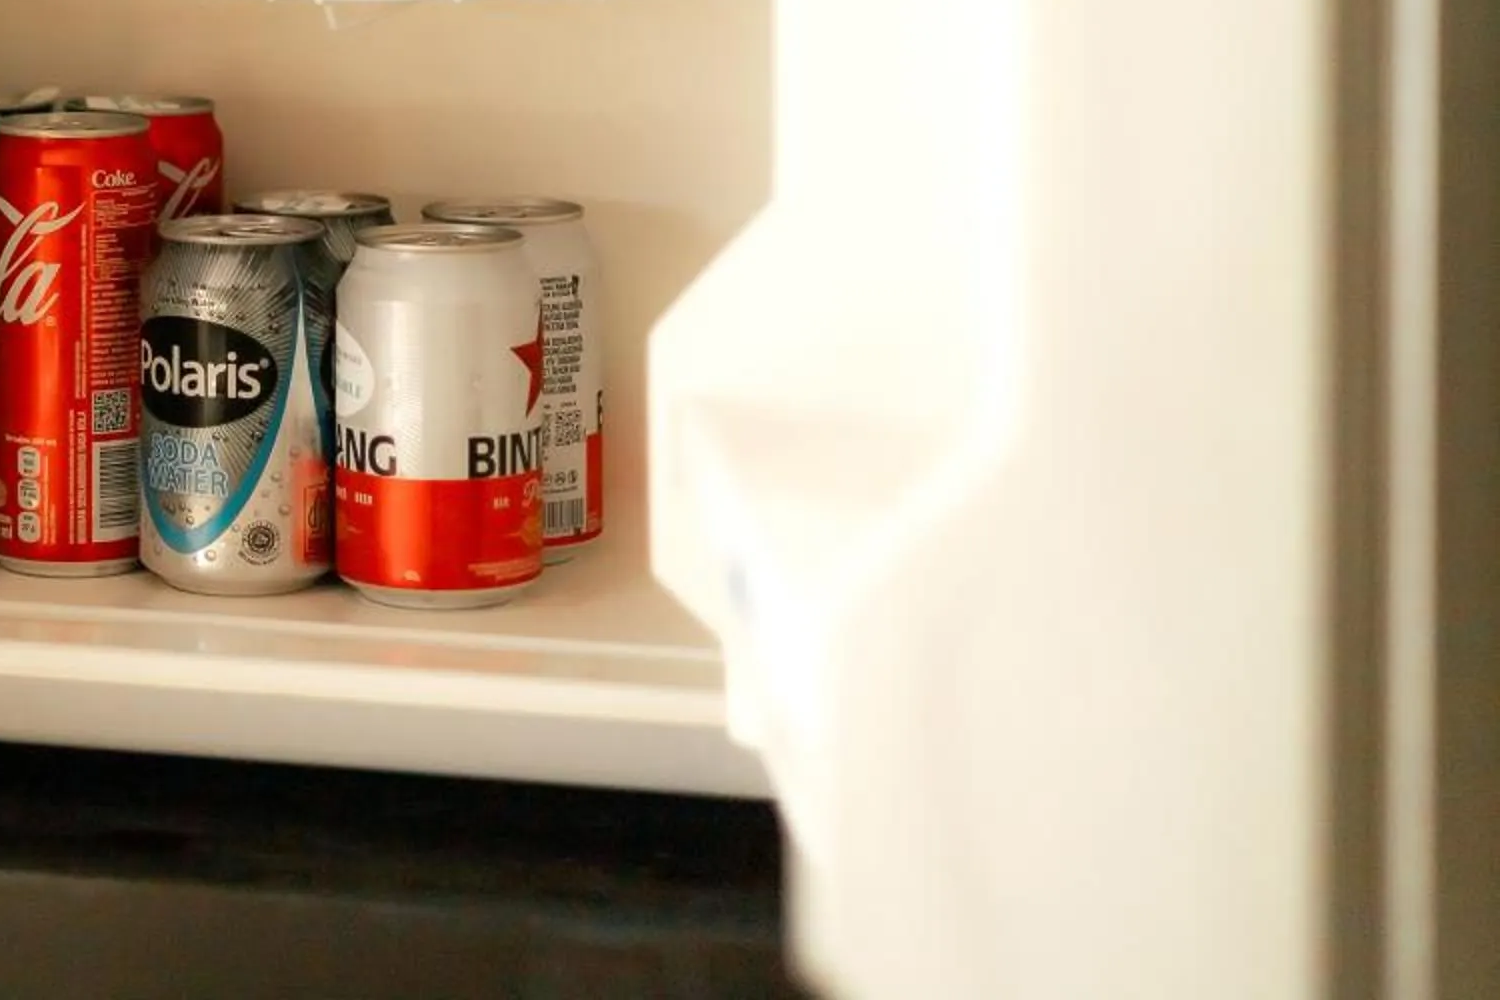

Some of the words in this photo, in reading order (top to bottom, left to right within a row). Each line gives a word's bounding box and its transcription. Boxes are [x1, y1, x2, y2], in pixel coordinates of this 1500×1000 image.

[141, 338, 263, 400] Polaris
[151, 432, 220, 468] SODA
[148, 458, 229, 499] WATER
